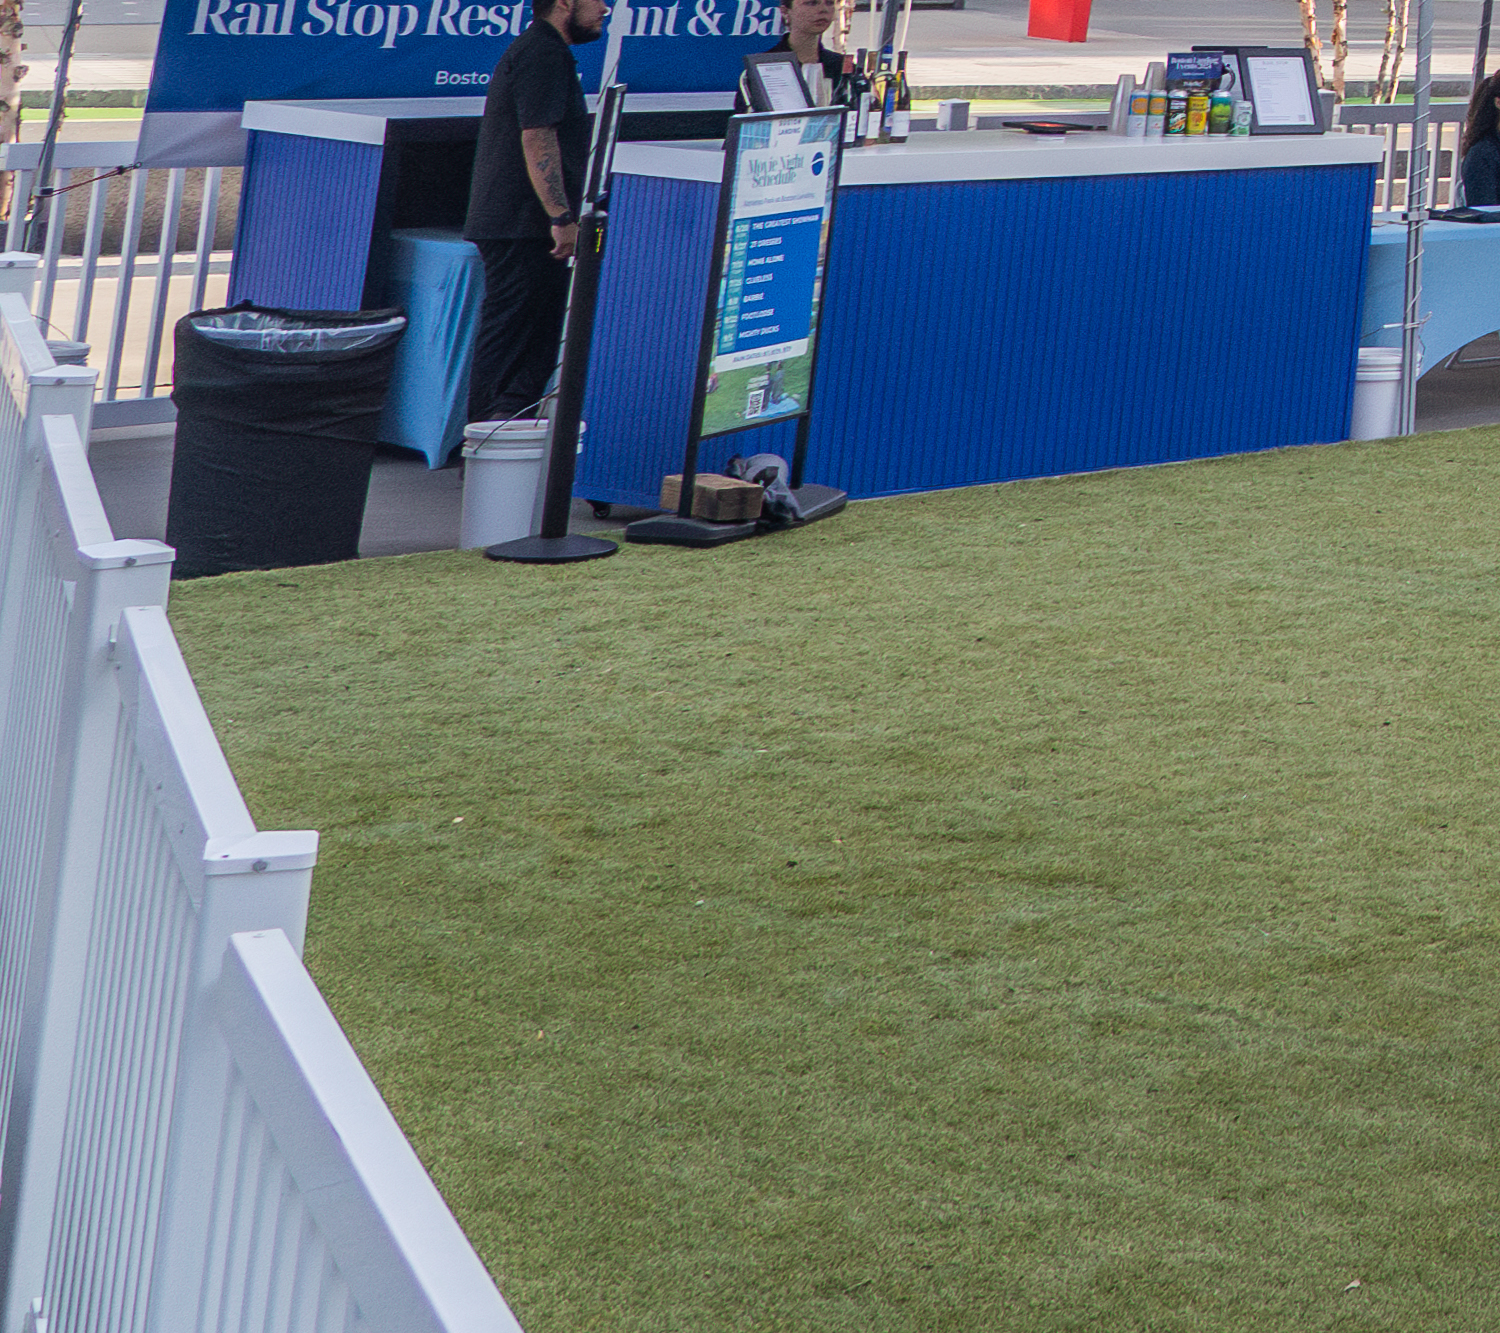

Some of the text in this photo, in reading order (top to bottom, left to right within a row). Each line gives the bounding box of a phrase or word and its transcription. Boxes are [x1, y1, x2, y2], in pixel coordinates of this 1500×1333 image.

[435, 70, 492, 86] Bosto
[748, 152, 805, 175] Movie Night
[751, 169, 798, 189] Schedule
